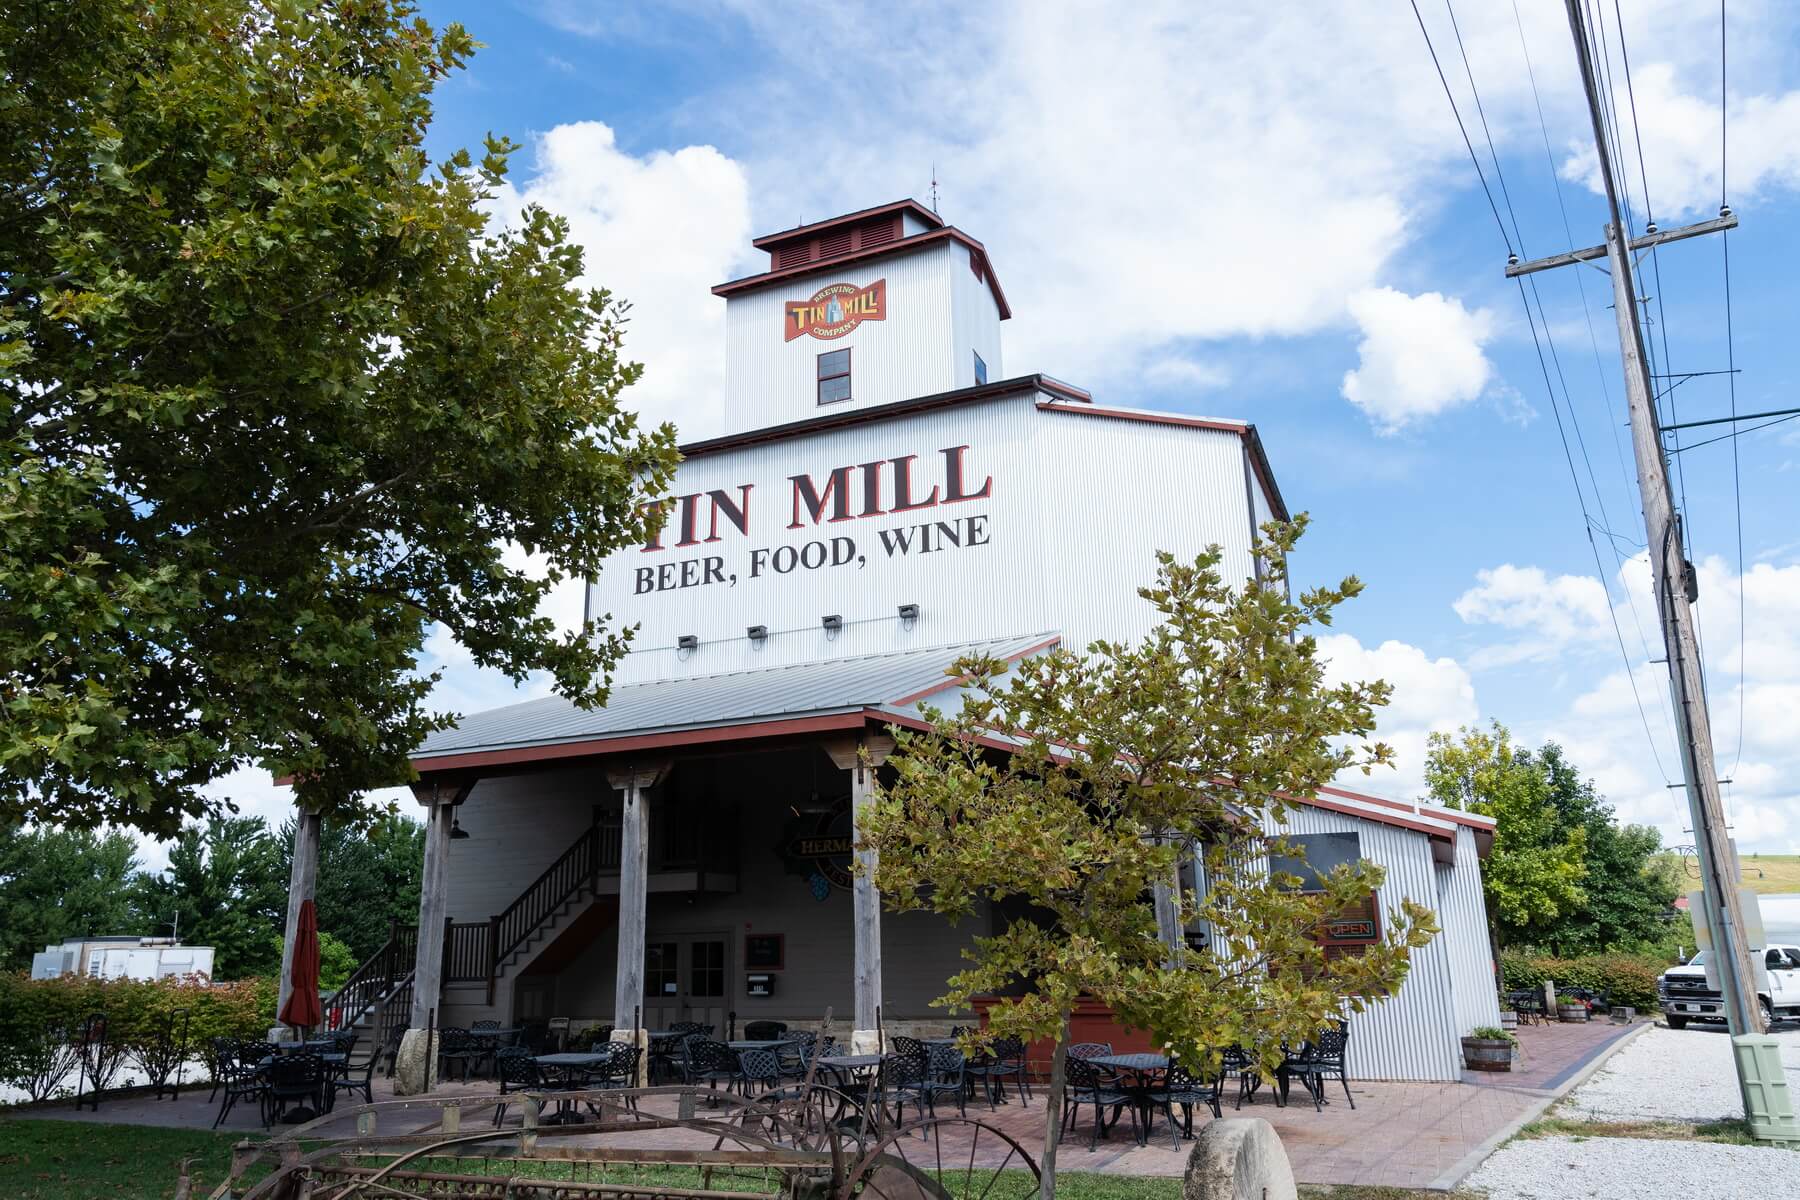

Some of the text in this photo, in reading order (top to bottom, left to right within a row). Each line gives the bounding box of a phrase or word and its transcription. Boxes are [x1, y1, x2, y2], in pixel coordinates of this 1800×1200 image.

[814, 286, 855, 303] BREWING
[793, 291, 878, 330] TIN MILL
[813, 319, 857, 337] COMPANY
[639, 445, 992, 553] TIN MILL
[633, 515, 991, 595] BEER, FOOD, WINE
[801, 839, 853, 854] HERM
[1329, 923, 1370, 935] OPEN
